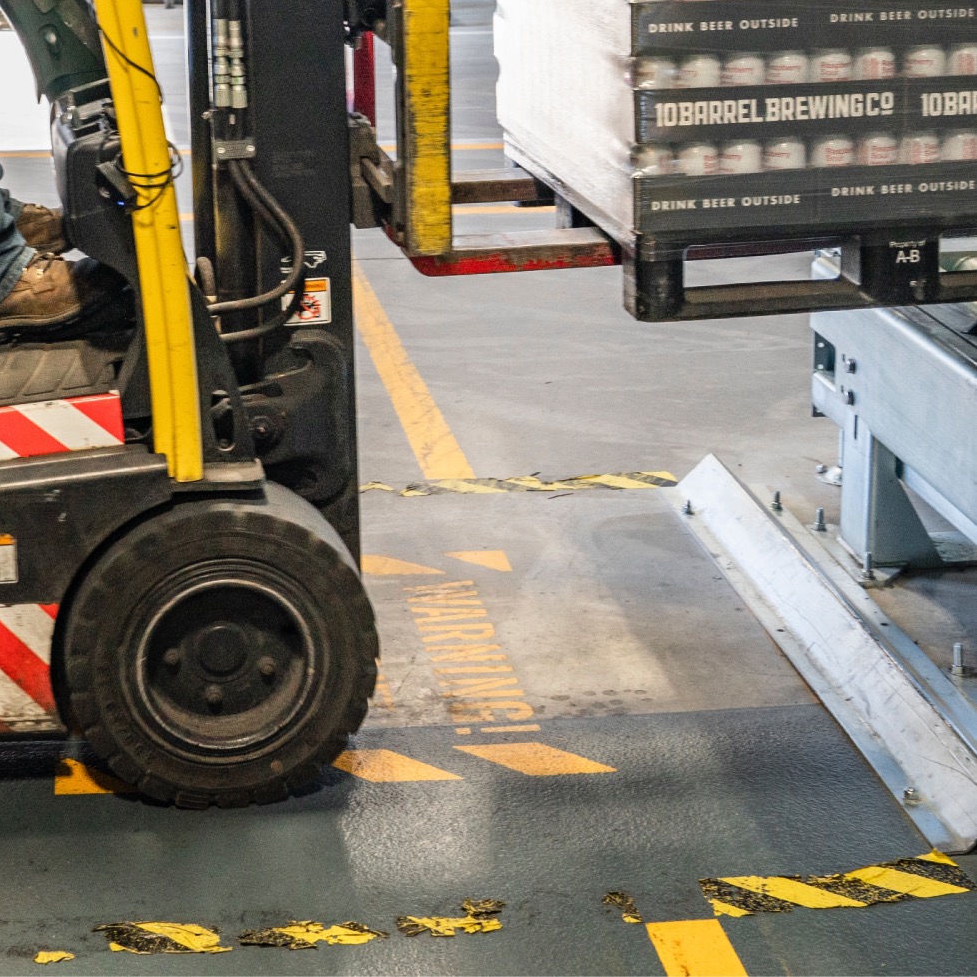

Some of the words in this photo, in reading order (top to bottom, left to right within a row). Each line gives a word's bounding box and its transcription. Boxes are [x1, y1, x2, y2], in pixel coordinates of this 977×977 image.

[830, 12, 874, 23] DRINK
[879, 11, 912, 21] BEER
[917, 8, 974, 19] OUTSIDE
[648, 22, 694, 33] DRINK
[700, 21, 733, 31] BEER
[739, 18, 798, 29] OUTSIDE
[920, 90, 977, 117] 10BA
[831, 185, 875, 197] DRINK
[880, 184, 913, 194] BEER
[918, 180, 975, 192] OUTSIDE
[651, 199, 697, 211] DRINK
[702, 198, 735, 208] BEER
[741, 195, 800, 206] OUTSIDE
[896, 249, 921, 263] A-B
